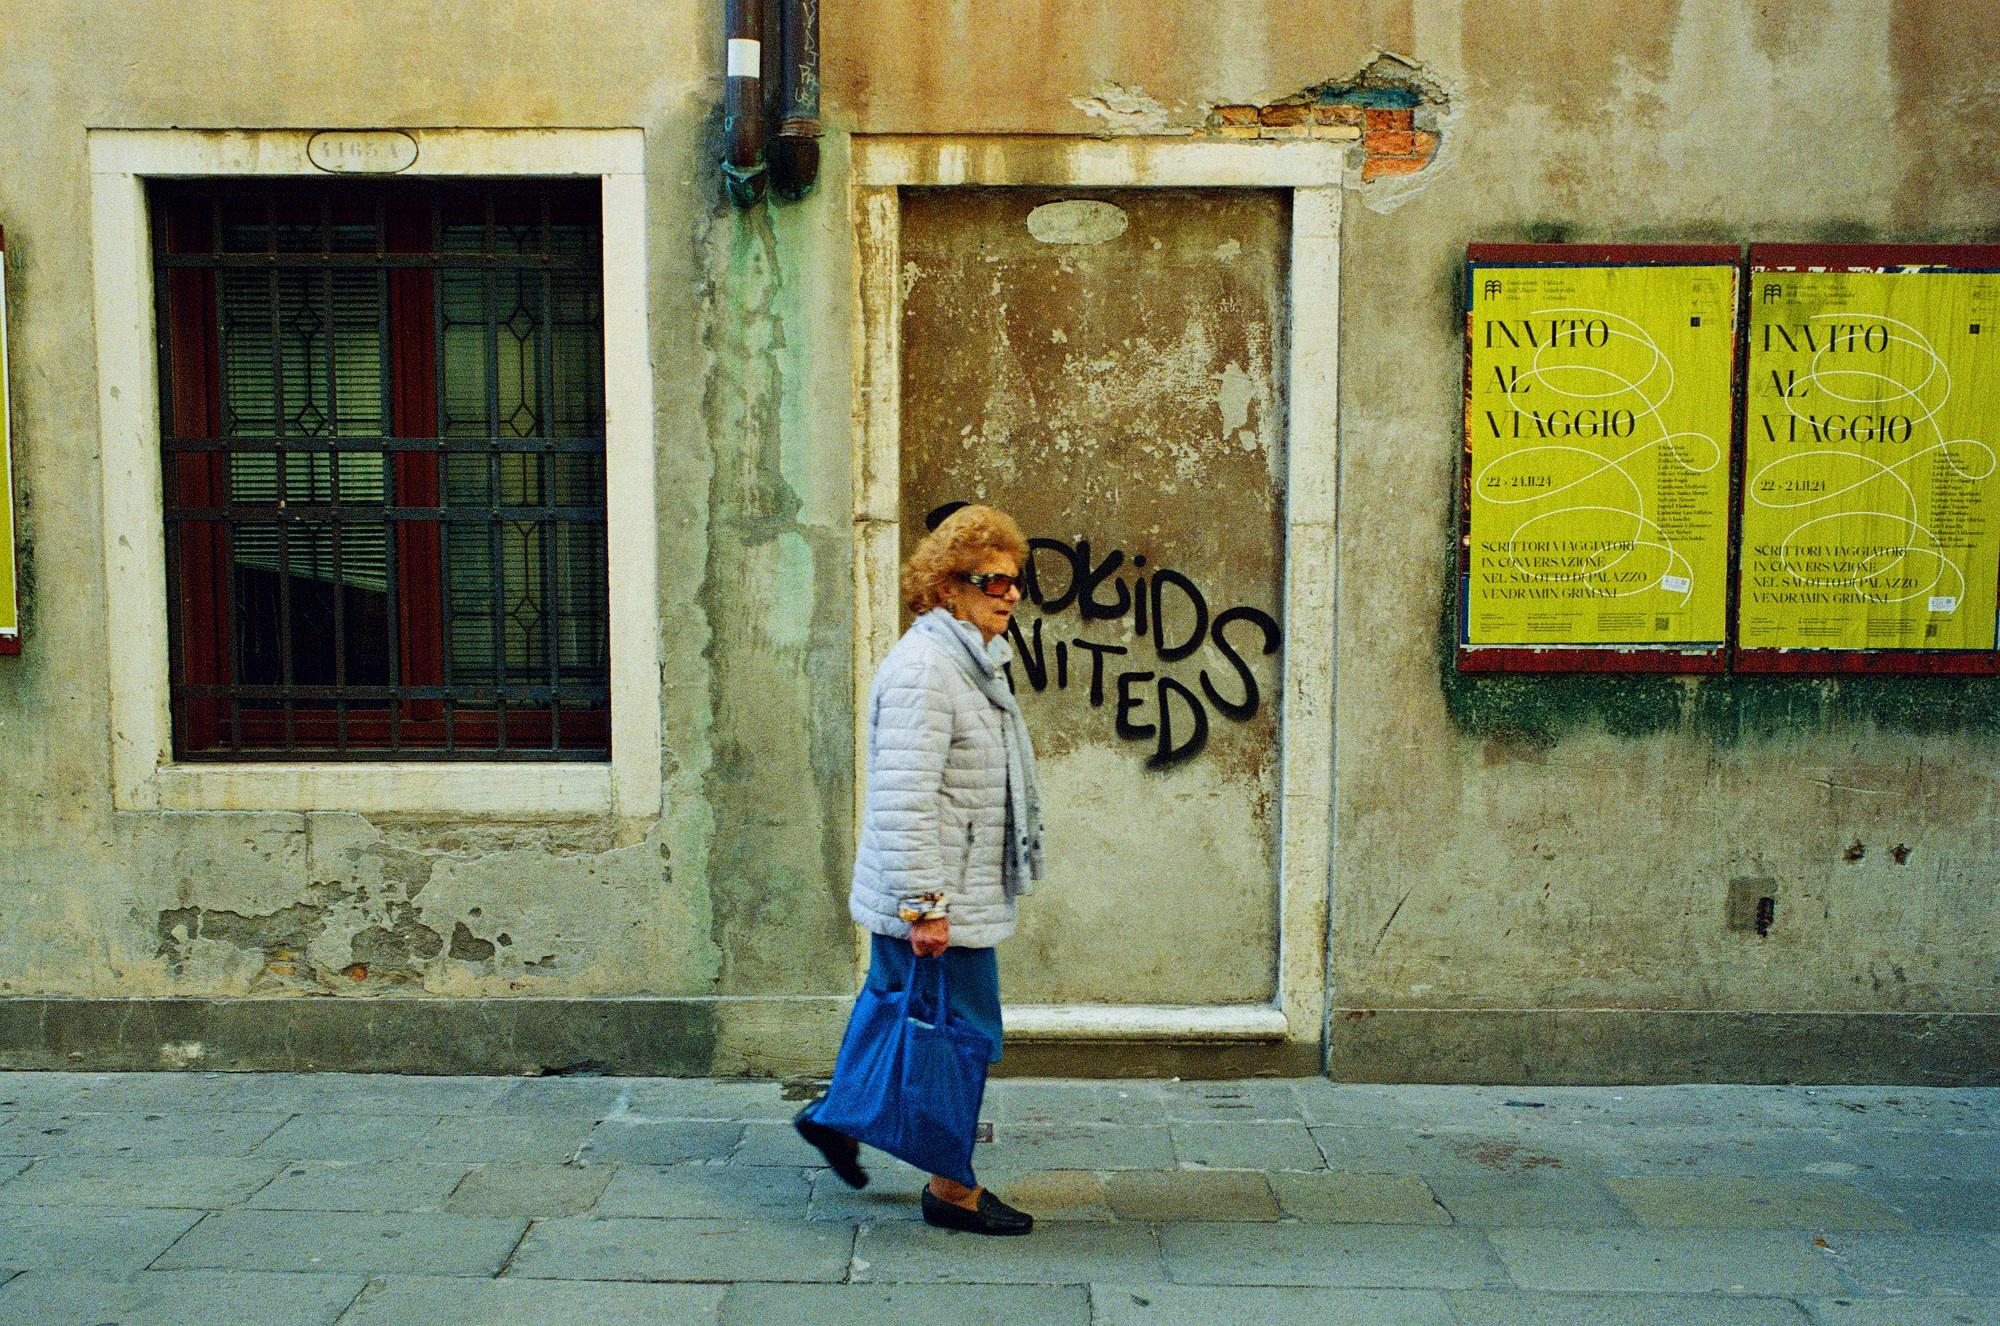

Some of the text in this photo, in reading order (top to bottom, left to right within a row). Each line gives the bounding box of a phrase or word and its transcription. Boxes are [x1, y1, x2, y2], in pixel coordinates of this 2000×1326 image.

[1484, 319, 1609, 348] INVITO
[1763, 323, 1889, 353] INVITO
[1484, 365, 1531, 394] AL
[1761, 369, 1809, 398] AL
[1485, 409, 1635, 438] VIAGGIO
[1761, 414, 1912, 443] VIAGGIO
[1486, 476, 1501, 487] 22
[1760, 481, 1774, 492] 22
[1481, 541, 1635, 552] SCRITTORI VIAGGIATORI
[1753, 545, 1908, 556] SCRITTORI VIAGGIATORI
[1481, 556, 1606, 568] IN CONVERSAZIONE
[1753, 561, 1877, 573] IN CONVERSAZIONE
[1481, 573, 1507, 584] NEL
[1509, 572, 1570, 584] SALOTTO
[1588, 571, 1648, 583] PALAZZO
[1753, 577, 1779, 588] NEL
[1781, 577, 1842, 588] SALOTTO
[1858, 577, 1919, 588] PALAZZO
[1481, 587, 1618, 599] VENDRAMIN GRIMANI
[1752, 592, 1889, 604] VENDRAMIN GRIMANI
